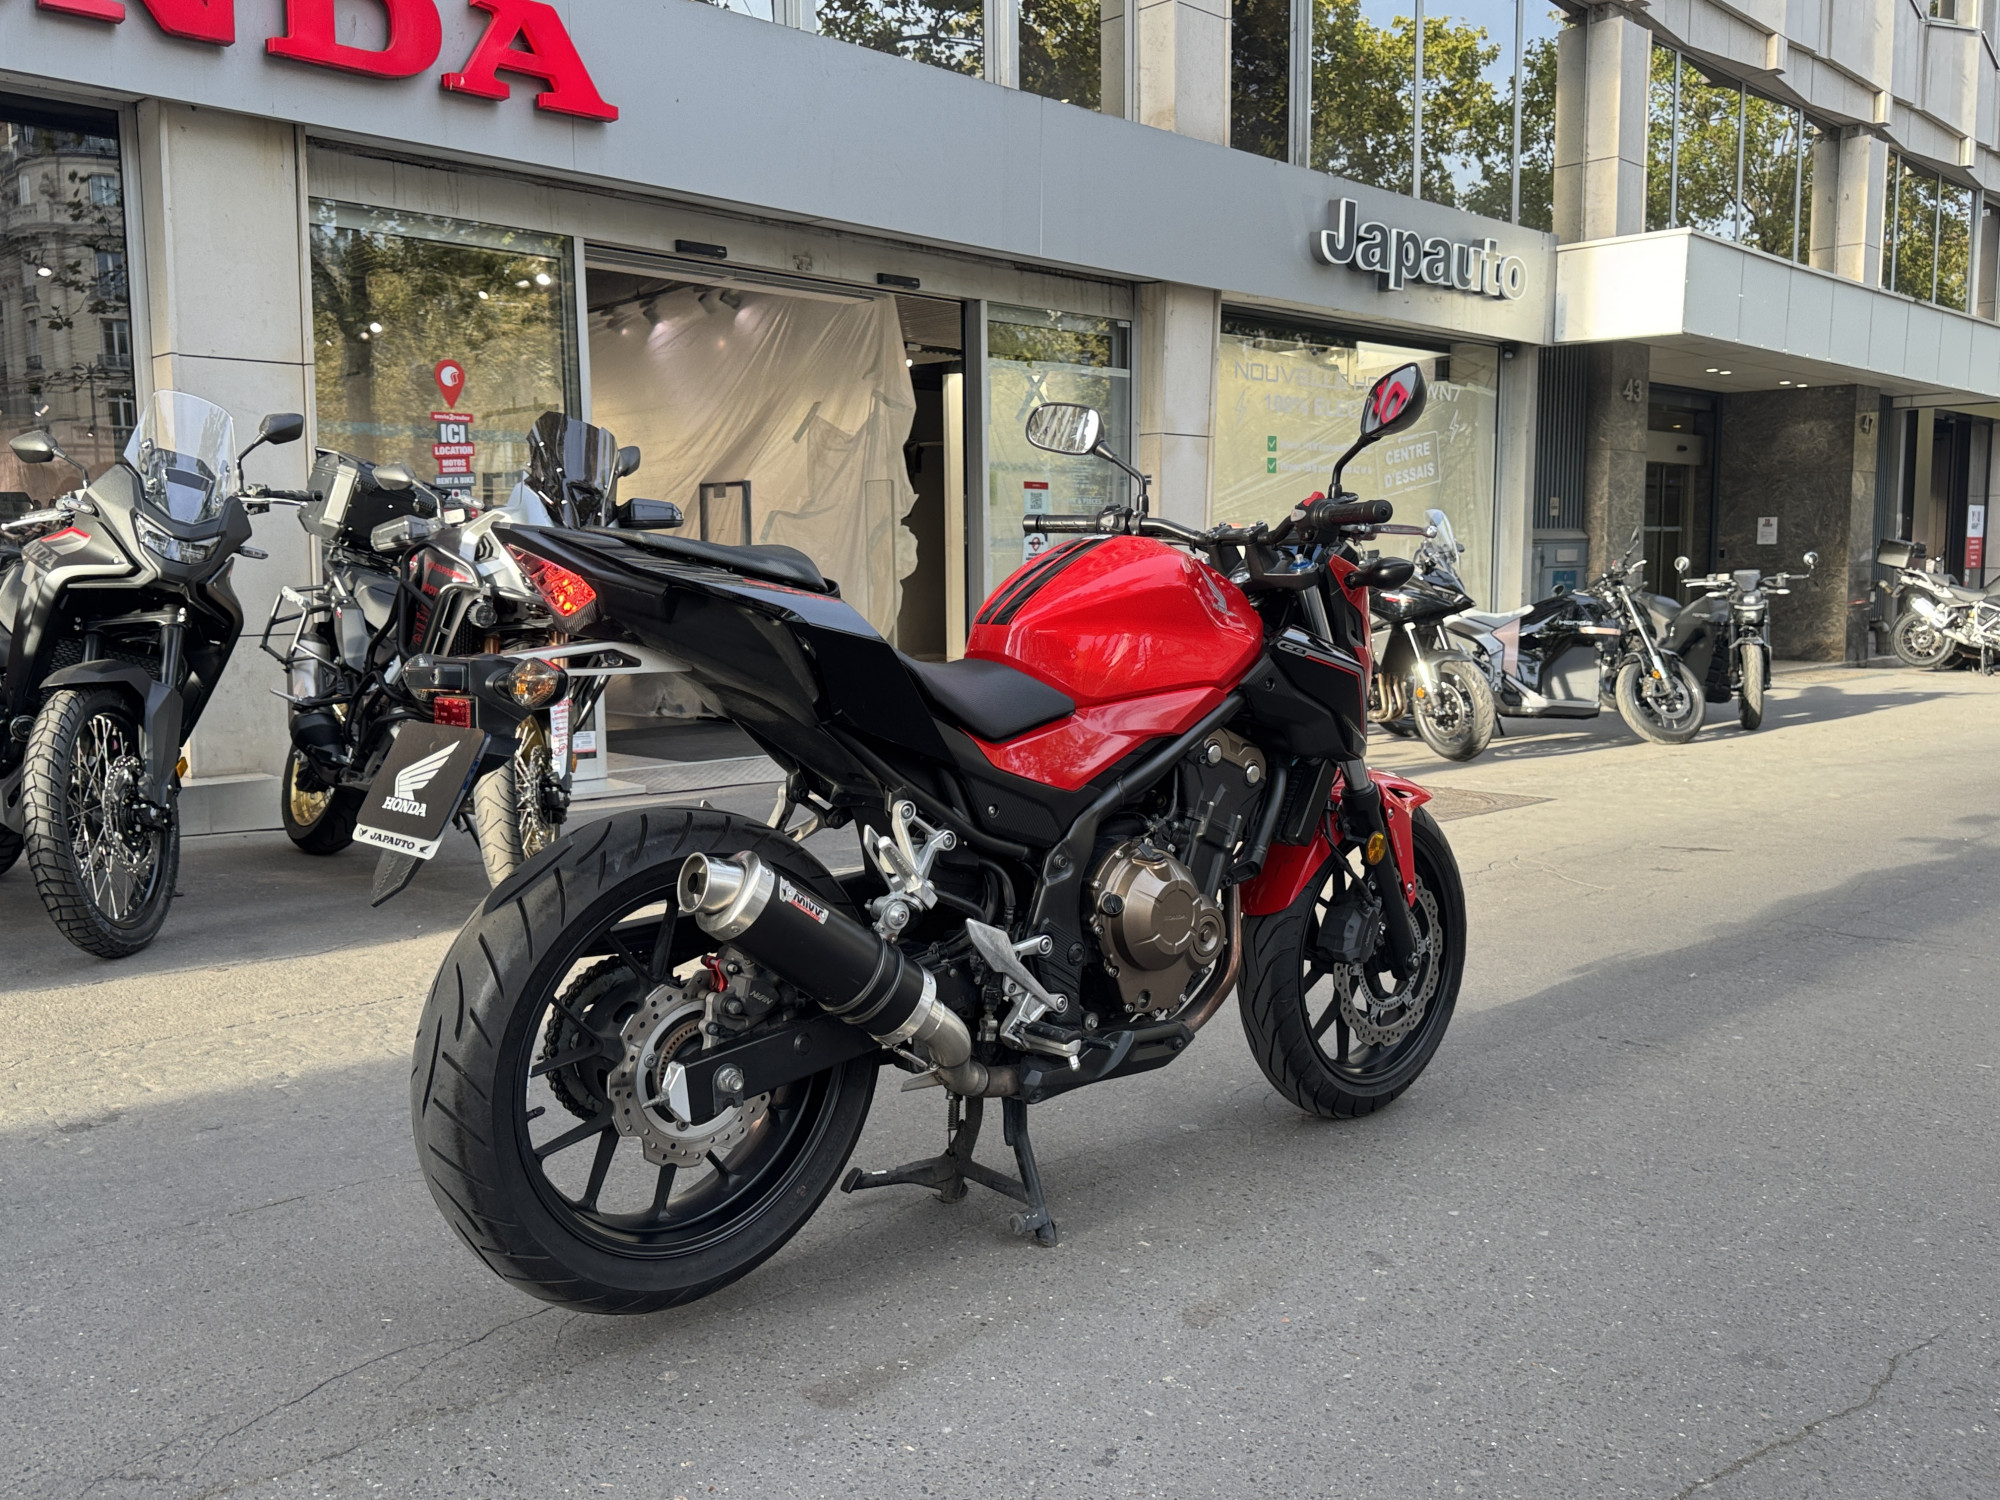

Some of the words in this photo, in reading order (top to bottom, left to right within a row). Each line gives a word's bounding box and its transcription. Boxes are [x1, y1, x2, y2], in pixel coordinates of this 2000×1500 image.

[1317, 198, 1528, 300] Japauto
[1622, 378, 1642, 402] 43
[440, 423, 466, 444] ICI
[434, 446, 473, 455] LOCATION
[1385, 442, 1431, 466] CENTRE
[1384, 463, 1435, 489] D'ESSAIS
[381, 796, 427, 817] HONDA
[370, 832, 415, 850] JAPAUTO
